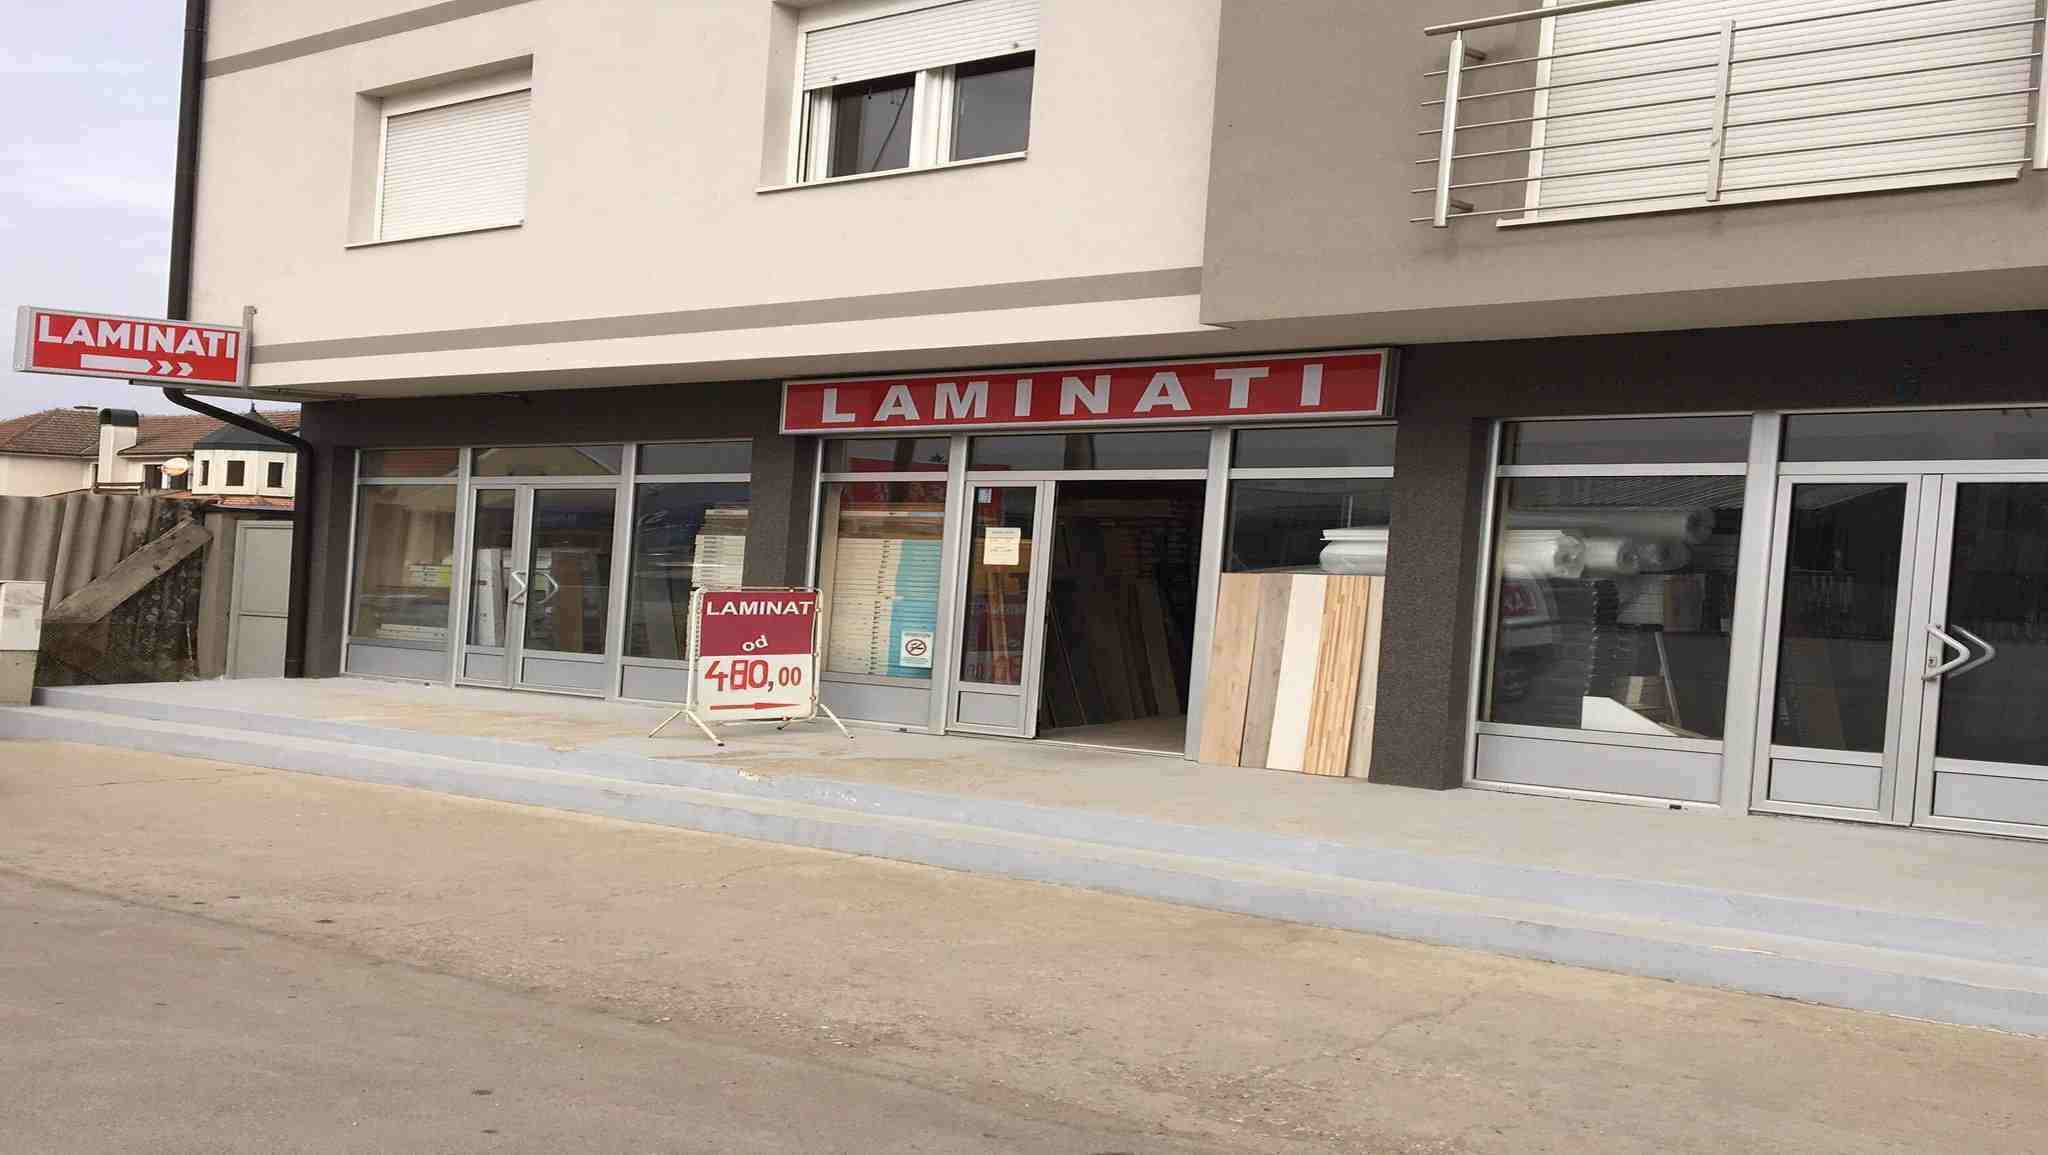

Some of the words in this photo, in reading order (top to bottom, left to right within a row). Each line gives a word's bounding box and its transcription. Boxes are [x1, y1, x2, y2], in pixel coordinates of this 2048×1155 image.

[38, 315, 237, 359] LAMINATI
[820, 363, 1325, 424] LAMINATI
[706, 601, 813, 616] LAMINAT
[742, 635, 768, 651] od
